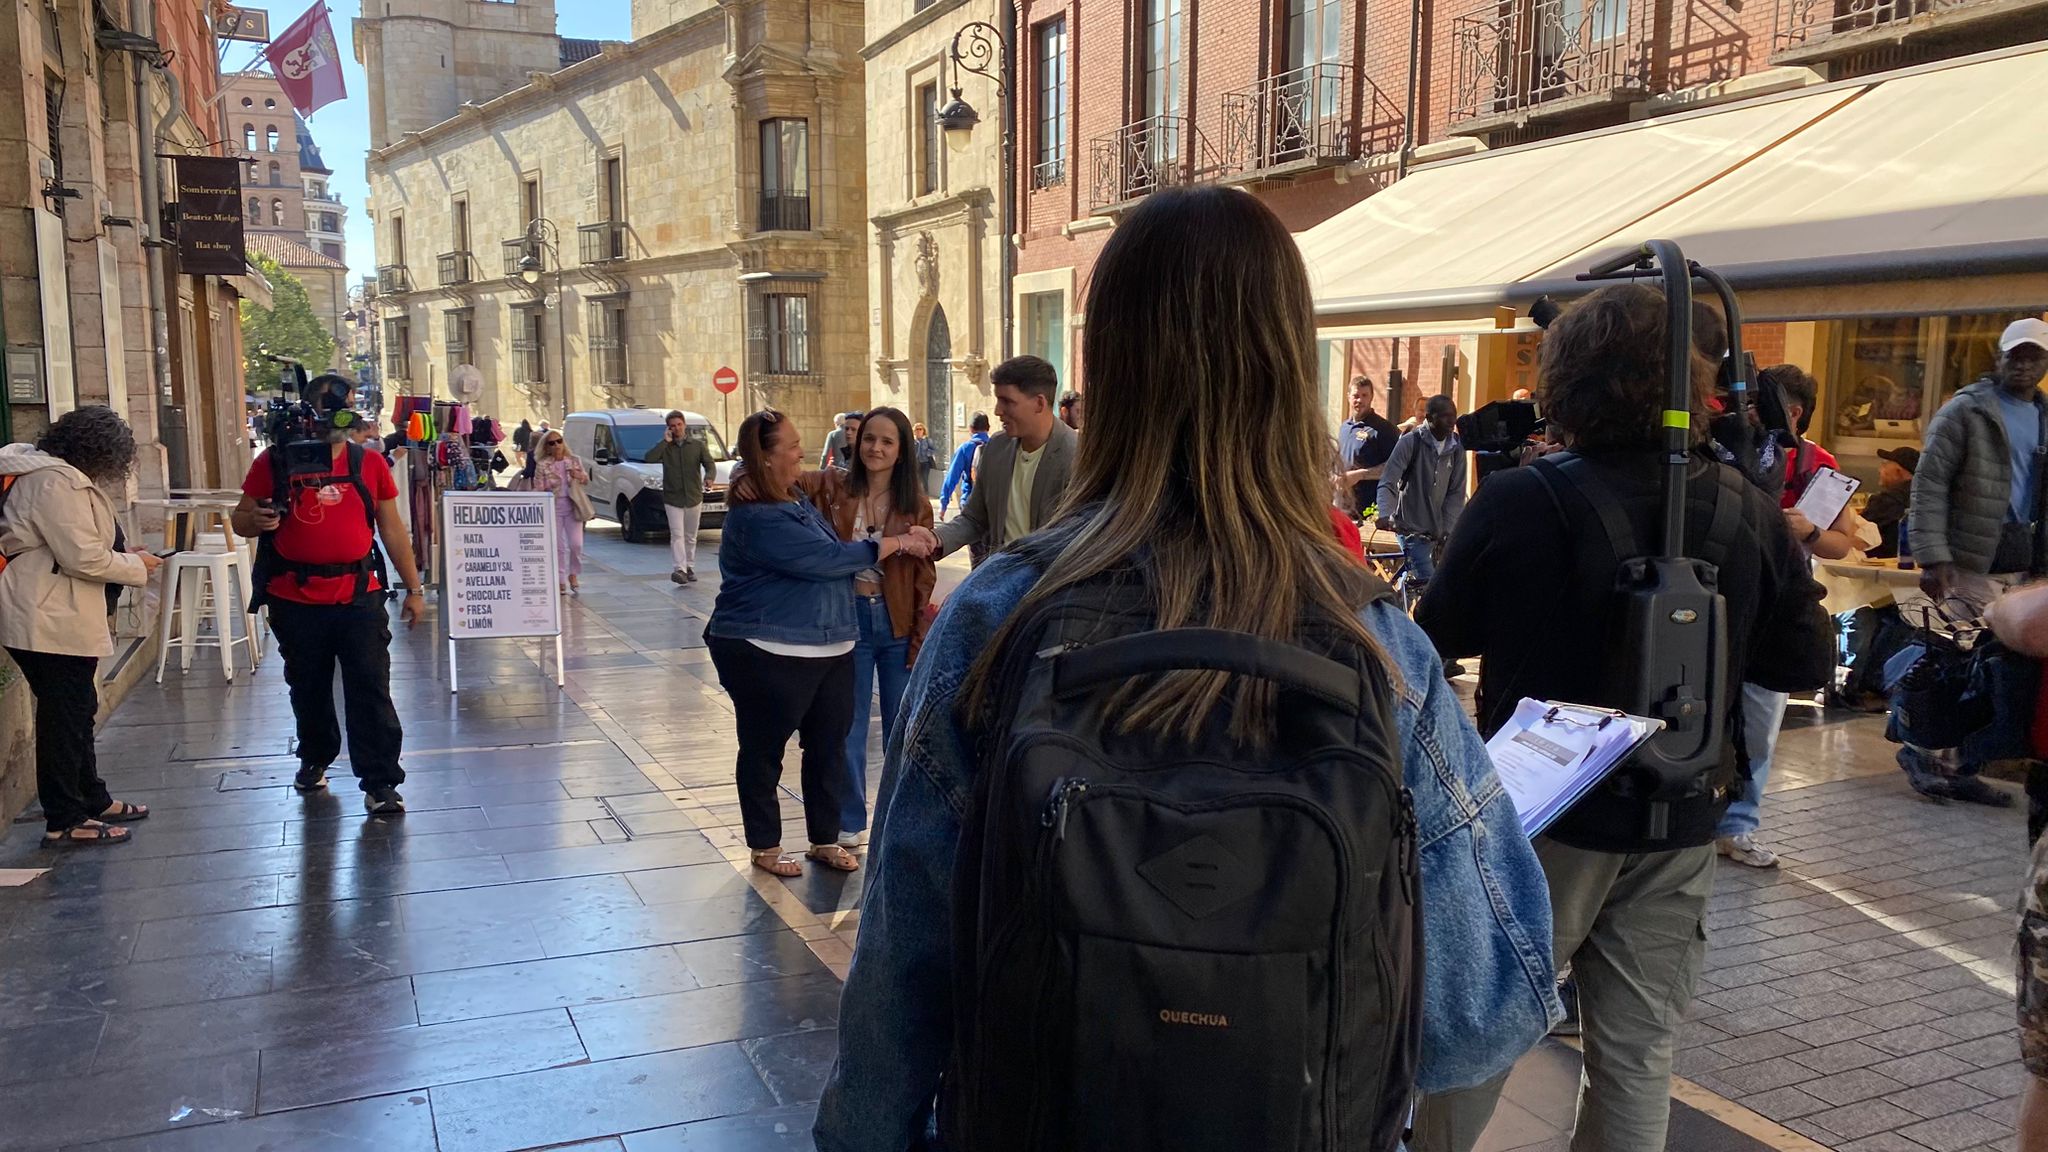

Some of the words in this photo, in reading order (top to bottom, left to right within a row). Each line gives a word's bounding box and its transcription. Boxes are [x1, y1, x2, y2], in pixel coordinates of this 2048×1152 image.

[181, 185, 236, 195] Sombrerería
[182, 212, 212, 221] Beatriz
[213, 214, 240, 223] Mielgo
[195, 241, 211, 249] Hat
[212, 242, 231, 252] shop
[453, 505, 505, 525] HELADOS
[508, 503, 545, 524] KAMÍN
[464, 534, 484, 544] NATA
[464, 548, 500, 558] VAINILLA
[465, 562, 497, 573] CARAMELO
[497, 562, 502, 572] Y
[502, 561, 514, 572] SAL
[465, 576, 506, 586] AVELLANA
[466, 589, 511, 601] CHOCOLATE
[466, 604, 492, 615] FRESA
[467, 617, 493, 629] LIMÓN
[1159, 1009, 1228, 1026] QUECHUA
